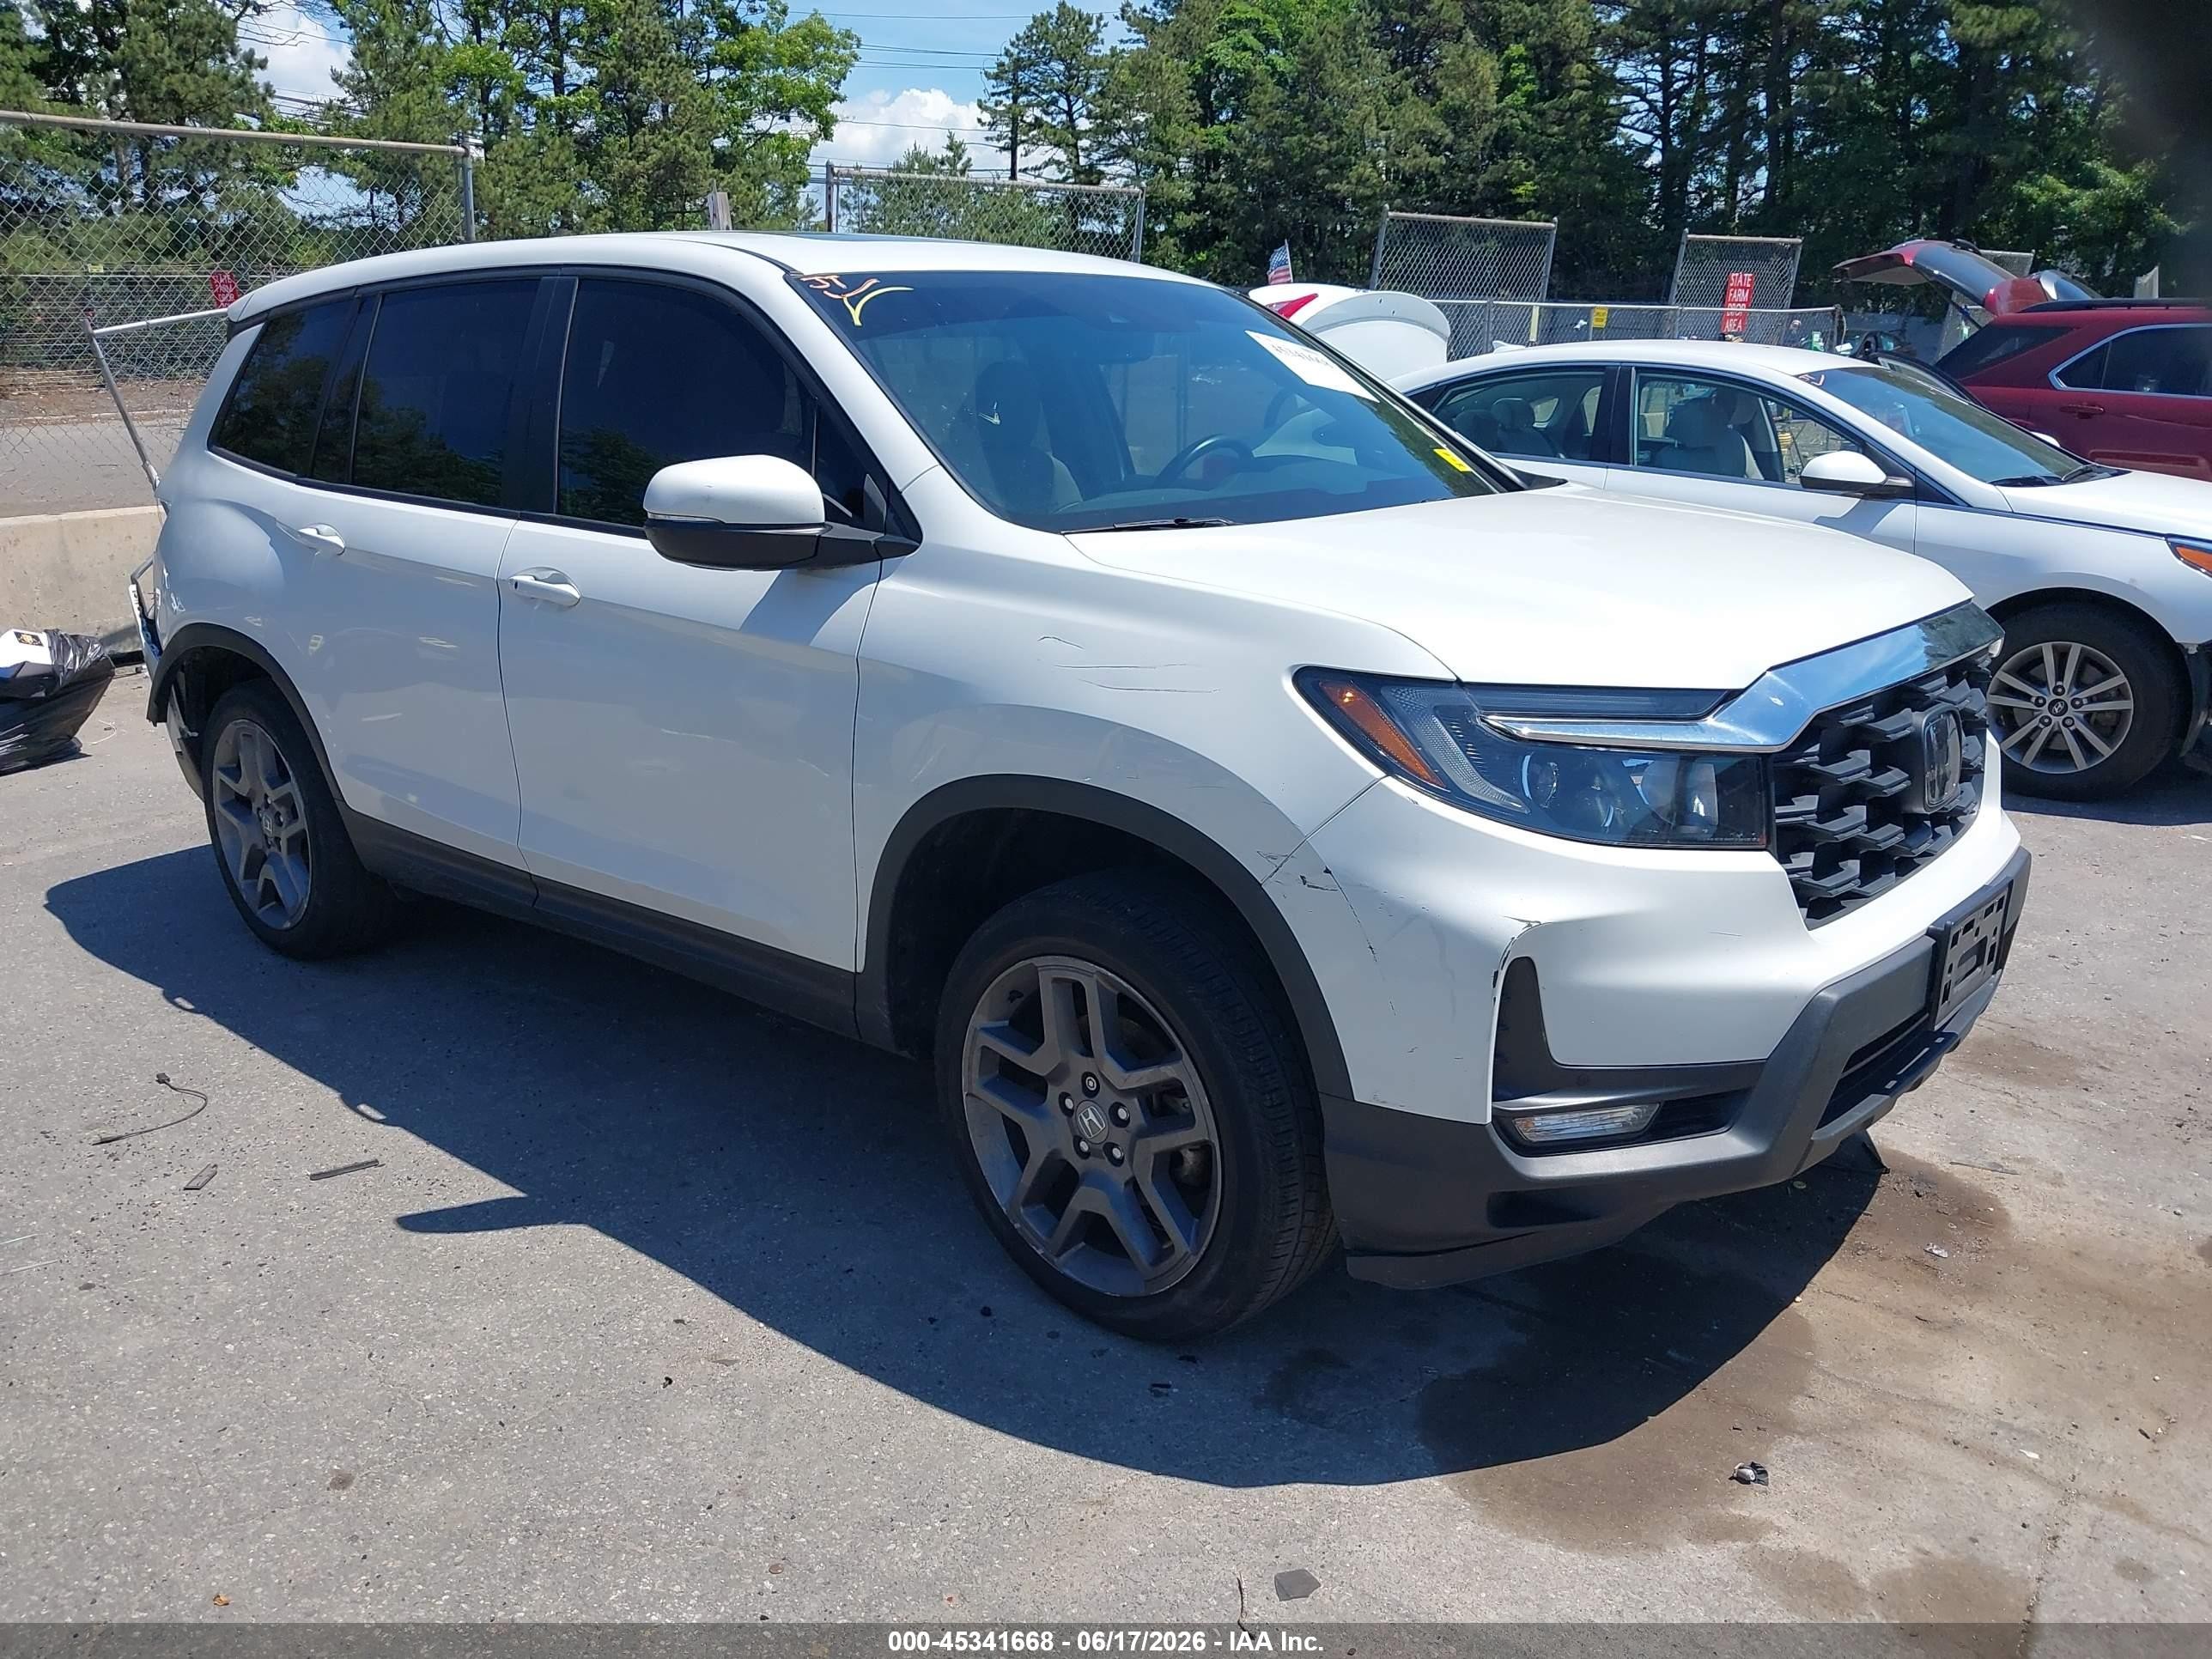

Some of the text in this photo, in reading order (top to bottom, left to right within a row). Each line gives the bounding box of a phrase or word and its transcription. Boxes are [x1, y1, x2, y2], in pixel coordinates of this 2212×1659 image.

[1729, 272, 1753, 287] STATE
[1728, 288, 1750, 302] FARM
[1723, 319, 1742, 333] AREA
